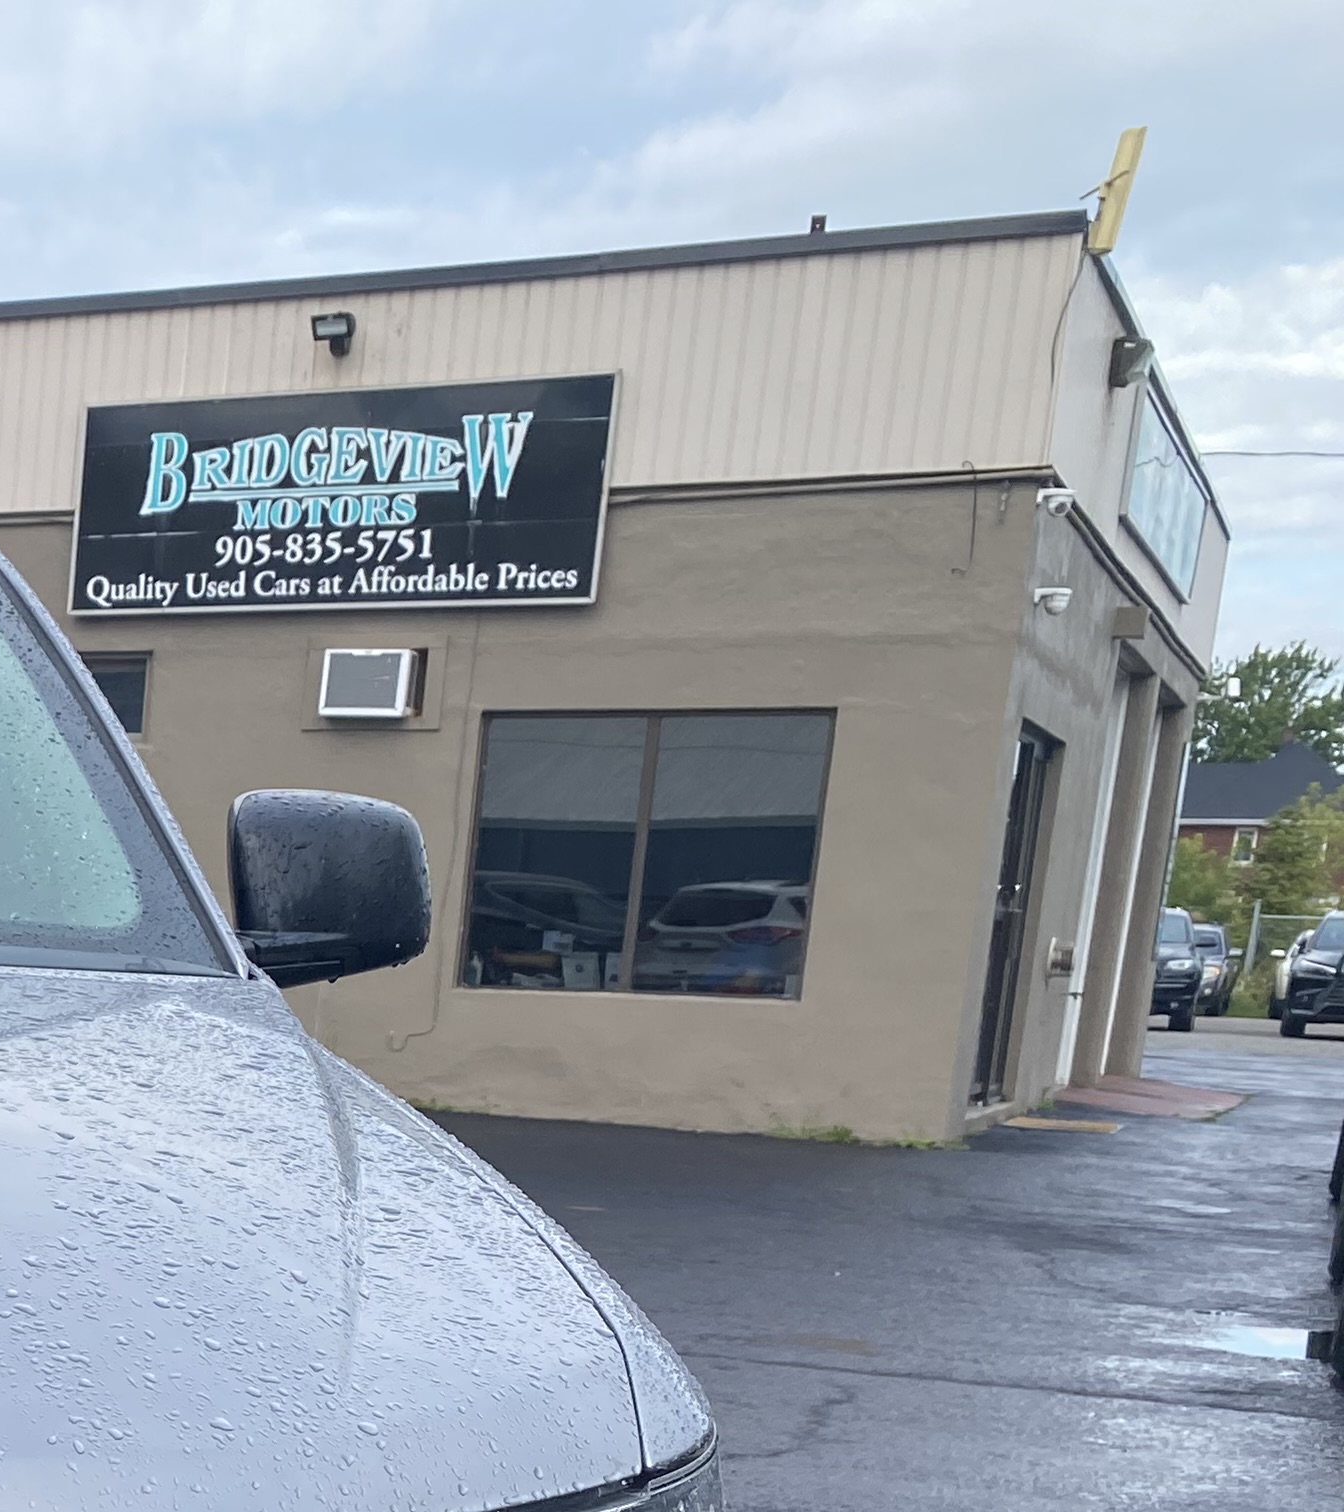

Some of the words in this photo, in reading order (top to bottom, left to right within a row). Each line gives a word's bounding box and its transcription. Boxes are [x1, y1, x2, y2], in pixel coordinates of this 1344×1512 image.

[139, 411, 533, 515] BRIDGEVIEW
[233, 493, 417, 530] MOTORS
[215, 528, 433, 567] 905-835-5751
[86, 573, 179, 607] Quality
[185, 570, 246, 598] Used
[253, 570, 310, 597] Cars
[317, 577, 342, 595] at
[348, 562, 489, 594] Affordable
[497, 562, 578, 589] Prices
